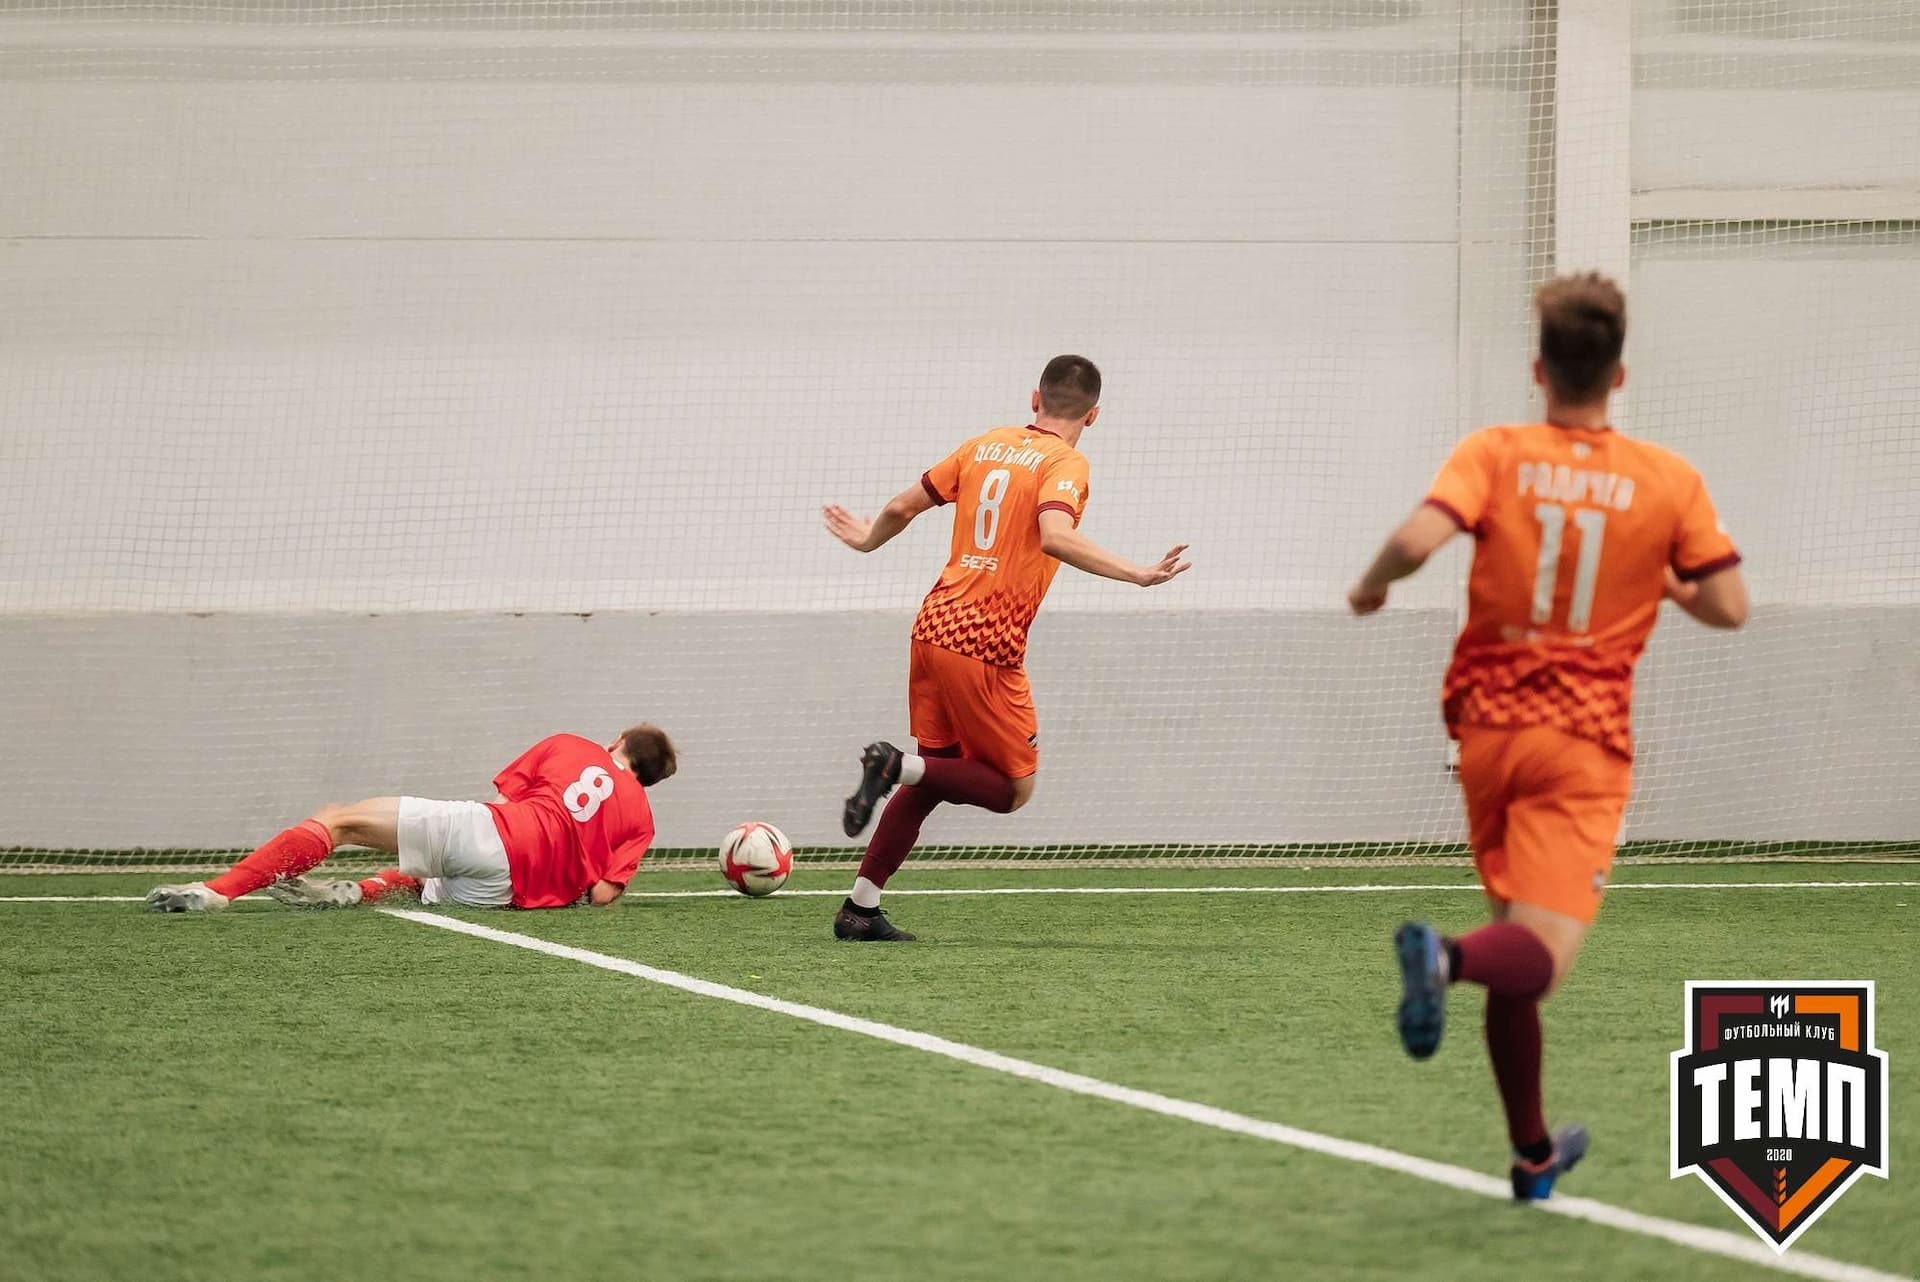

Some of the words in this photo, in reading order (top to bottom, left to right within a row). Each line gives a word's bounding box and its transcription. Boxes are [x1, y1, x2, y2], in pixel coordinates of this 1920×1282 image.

[974, 468, 1011, 551] 8
[1531, 502, 1606, 634] 11
[562, 765, 615, 823] 8
